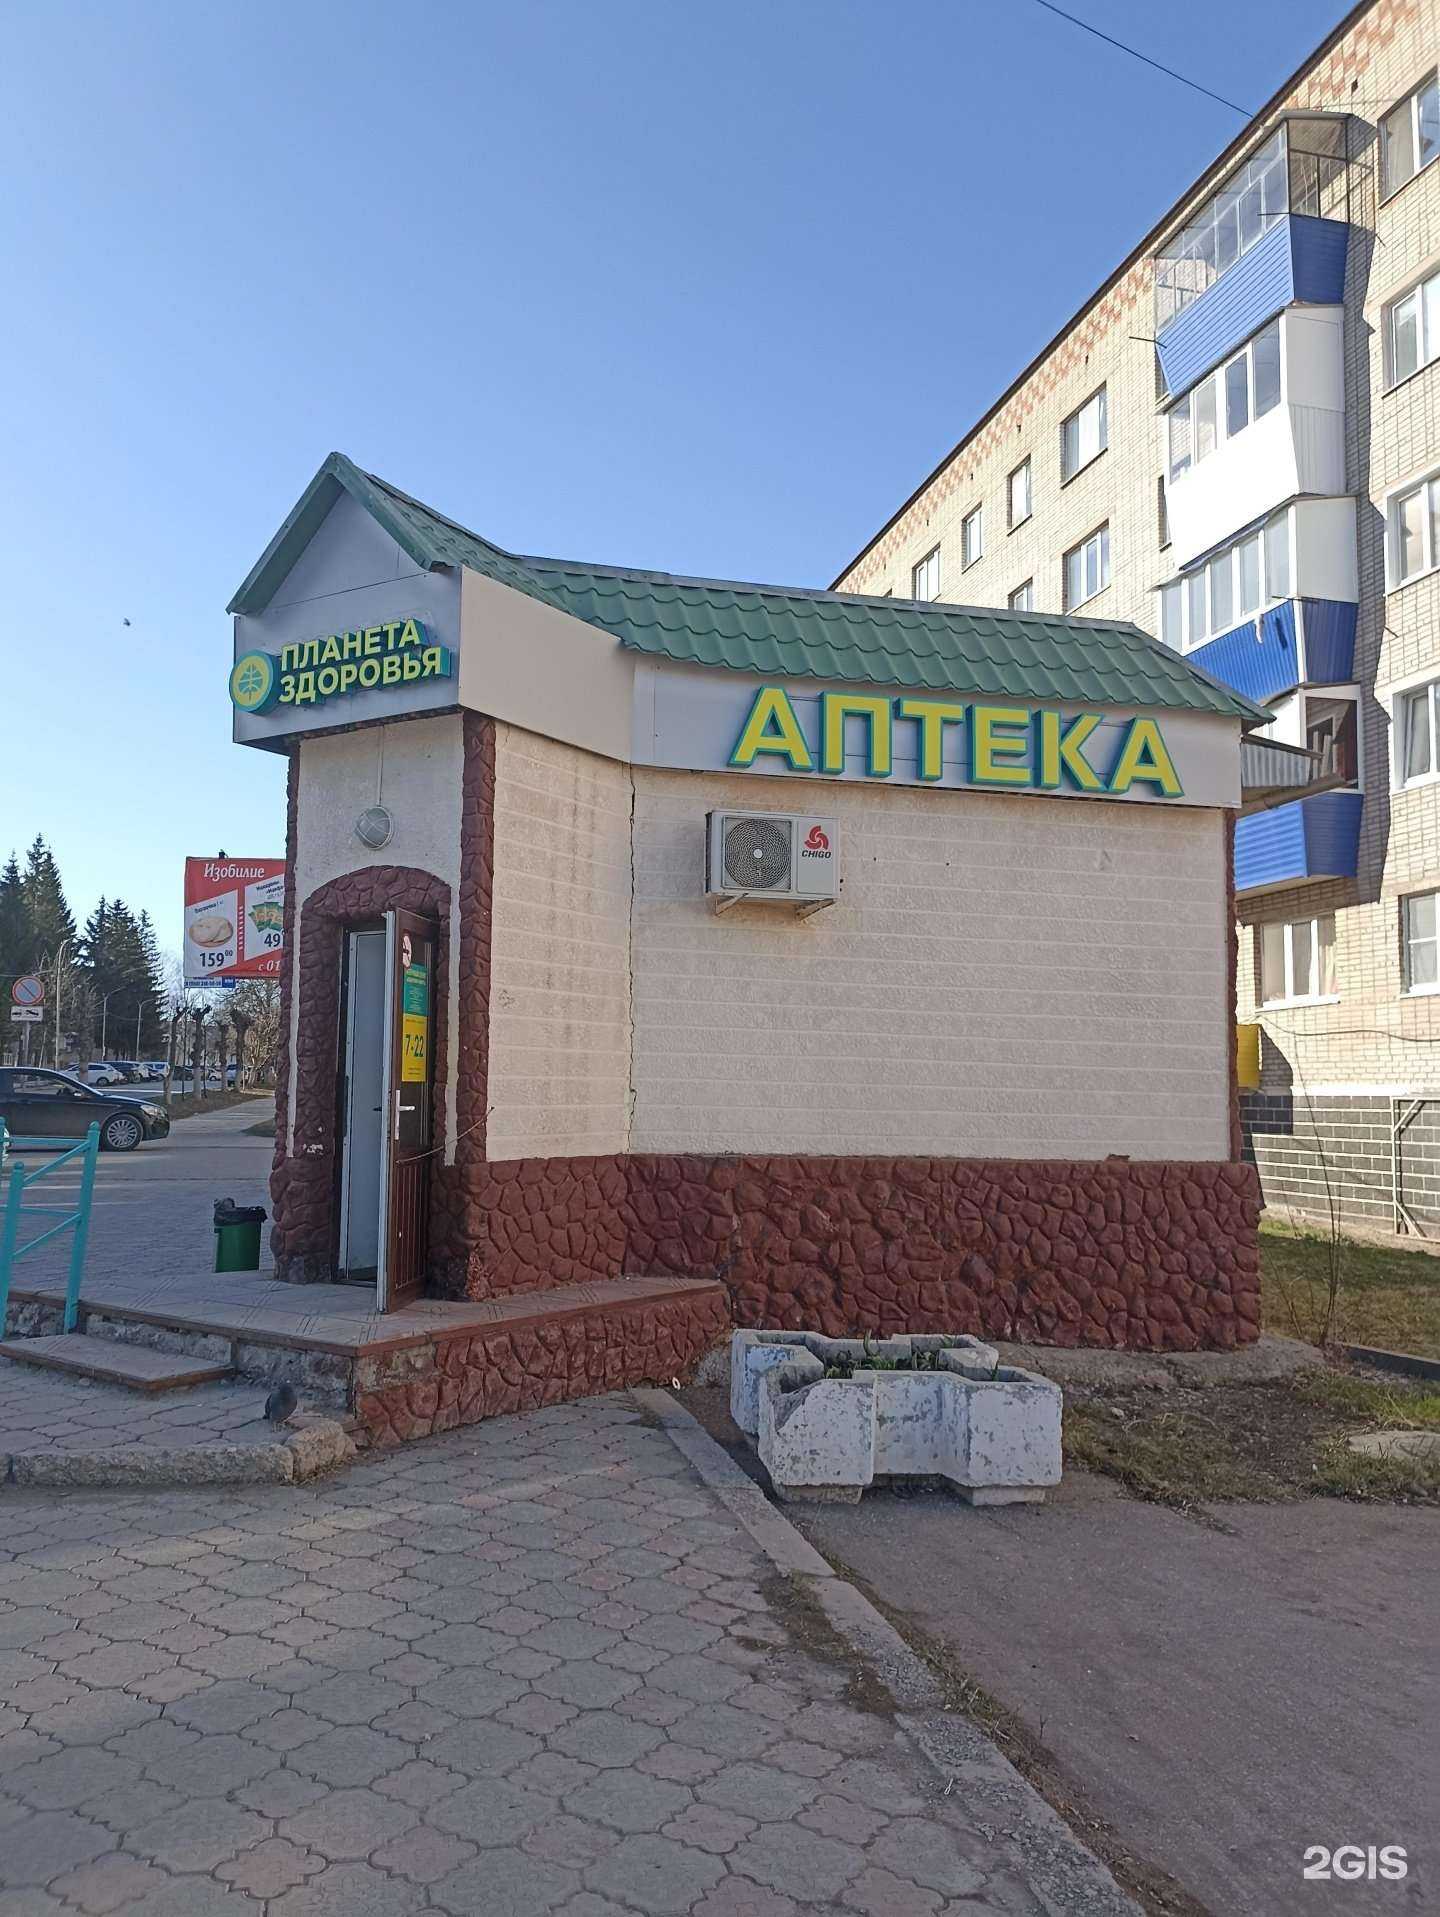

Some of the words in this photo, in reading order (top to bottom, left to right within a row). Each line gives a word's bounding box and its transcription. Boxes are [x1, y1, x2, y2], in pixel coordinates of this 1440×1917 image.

[280, 618, 425, 673] ПЛАНЕТА
[278, 646, 445, 705] ЗДОРОВЬЯ
[727, 685, 1184, 798] АПТЕКА
[801, 849, 832, 859] CHIGO
[203, 863, 265, 882] Изобилие
[264, 933, 281, 947] 49
[200, 952, 225, 967] 159
